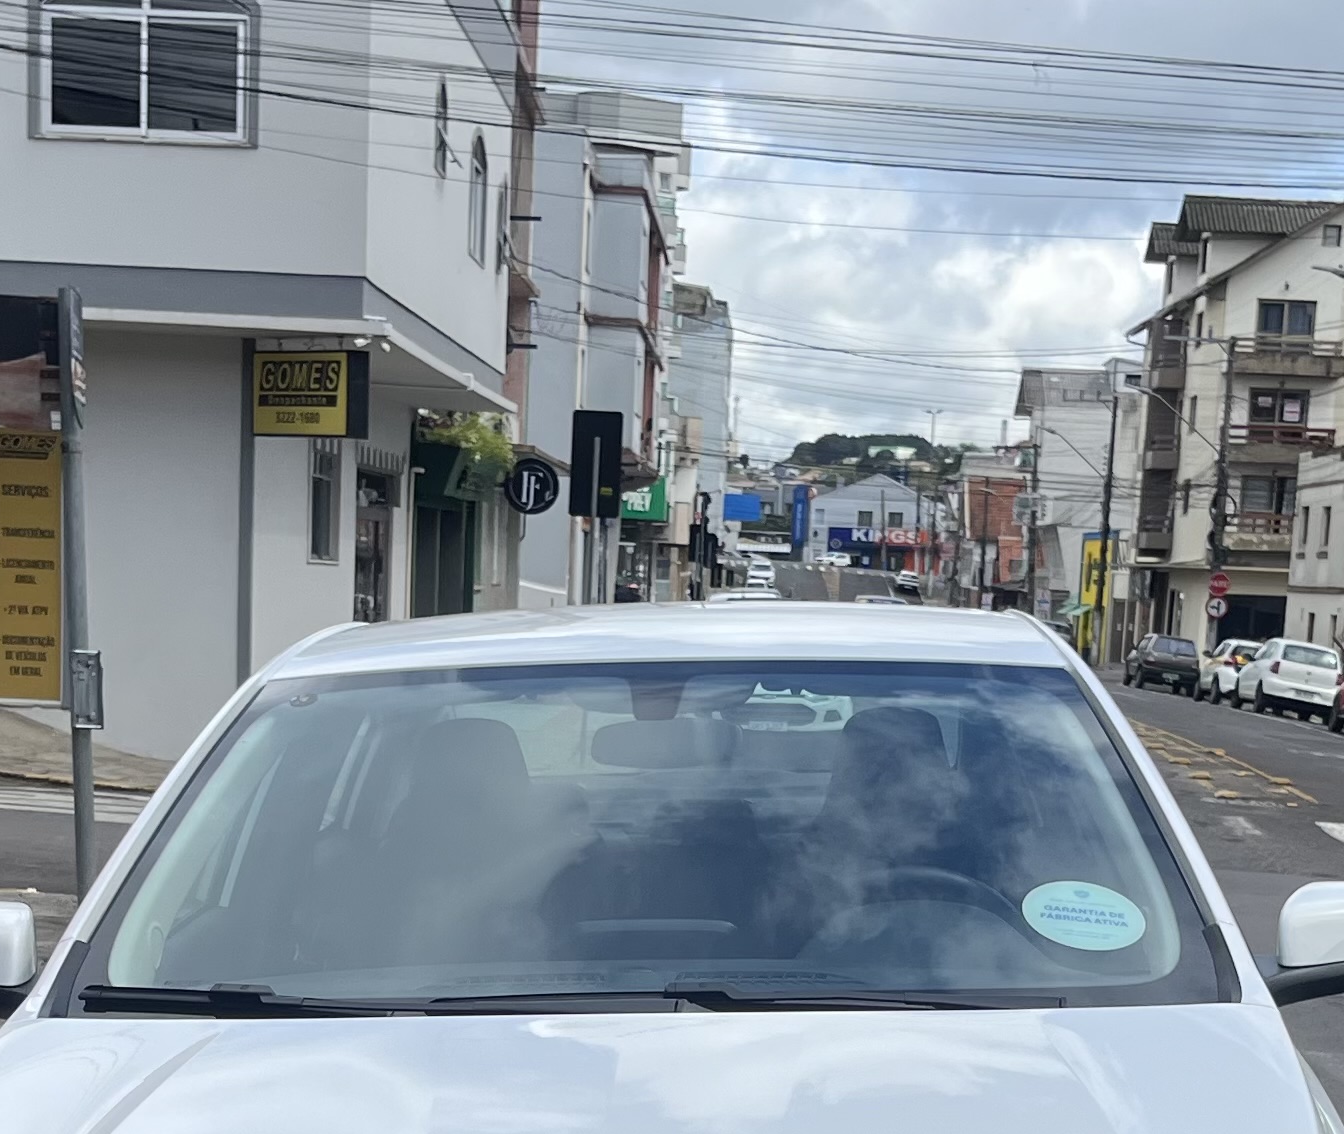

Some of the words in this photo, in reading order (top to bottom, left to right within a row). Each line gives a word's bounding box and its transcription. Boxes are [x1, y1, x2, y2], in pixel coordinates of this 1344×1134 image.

[260, 361, 341, 391] GOMES
[1043, 904, 1107, 917] GARANTIA
[1109, 911, 1126, 920] DE
[1094, 918, 1129, 928] ATIVA
